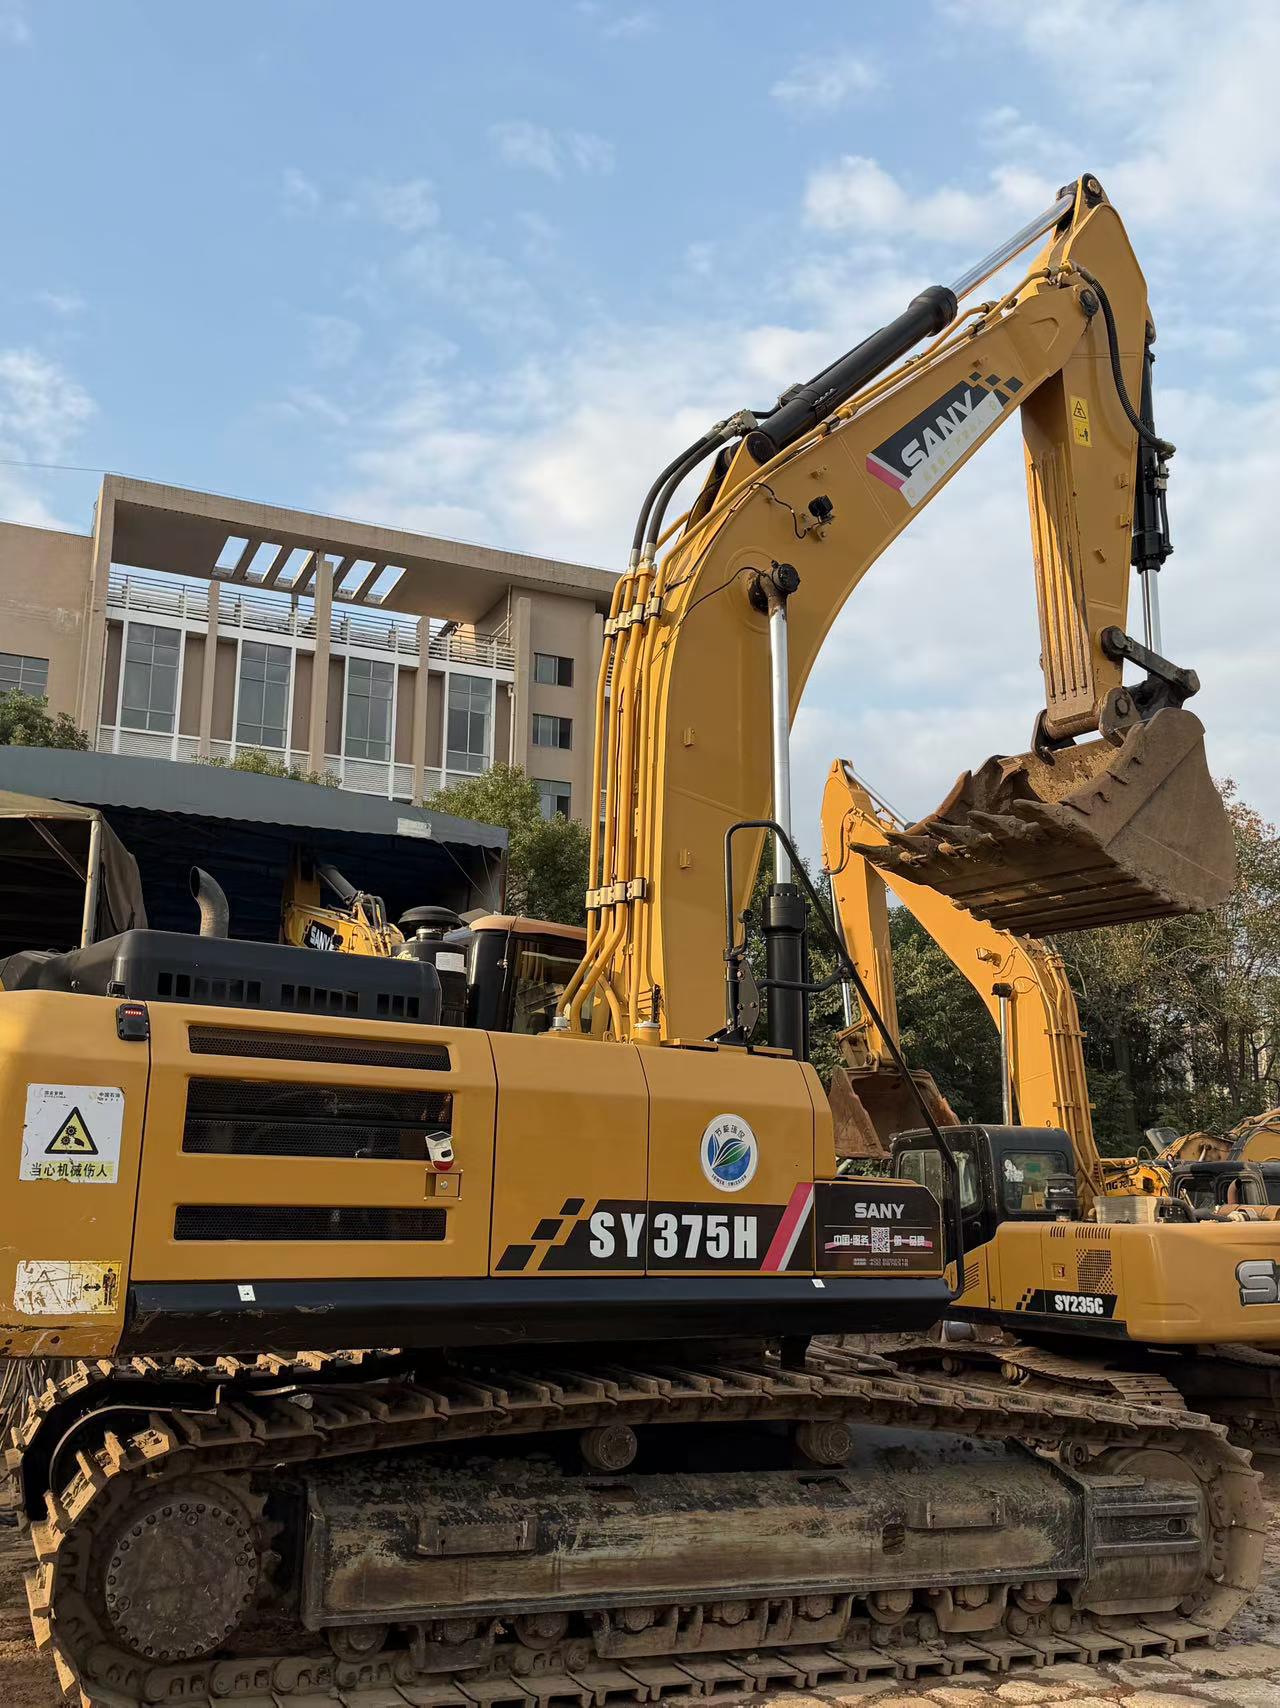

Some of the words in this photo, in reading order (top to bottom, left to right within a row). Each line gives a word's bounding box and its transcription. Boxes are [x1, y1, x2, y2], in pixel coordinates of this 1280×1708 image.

[901, 389, 973, 468] SANY
[31, 1163, 107, 1177] 当心机械伤人
[854, 1202, 905, 1219] SANY
[590, 1212, 757, 1259] SY375H
[1054, 1294, 1104, 1315] SY235C
